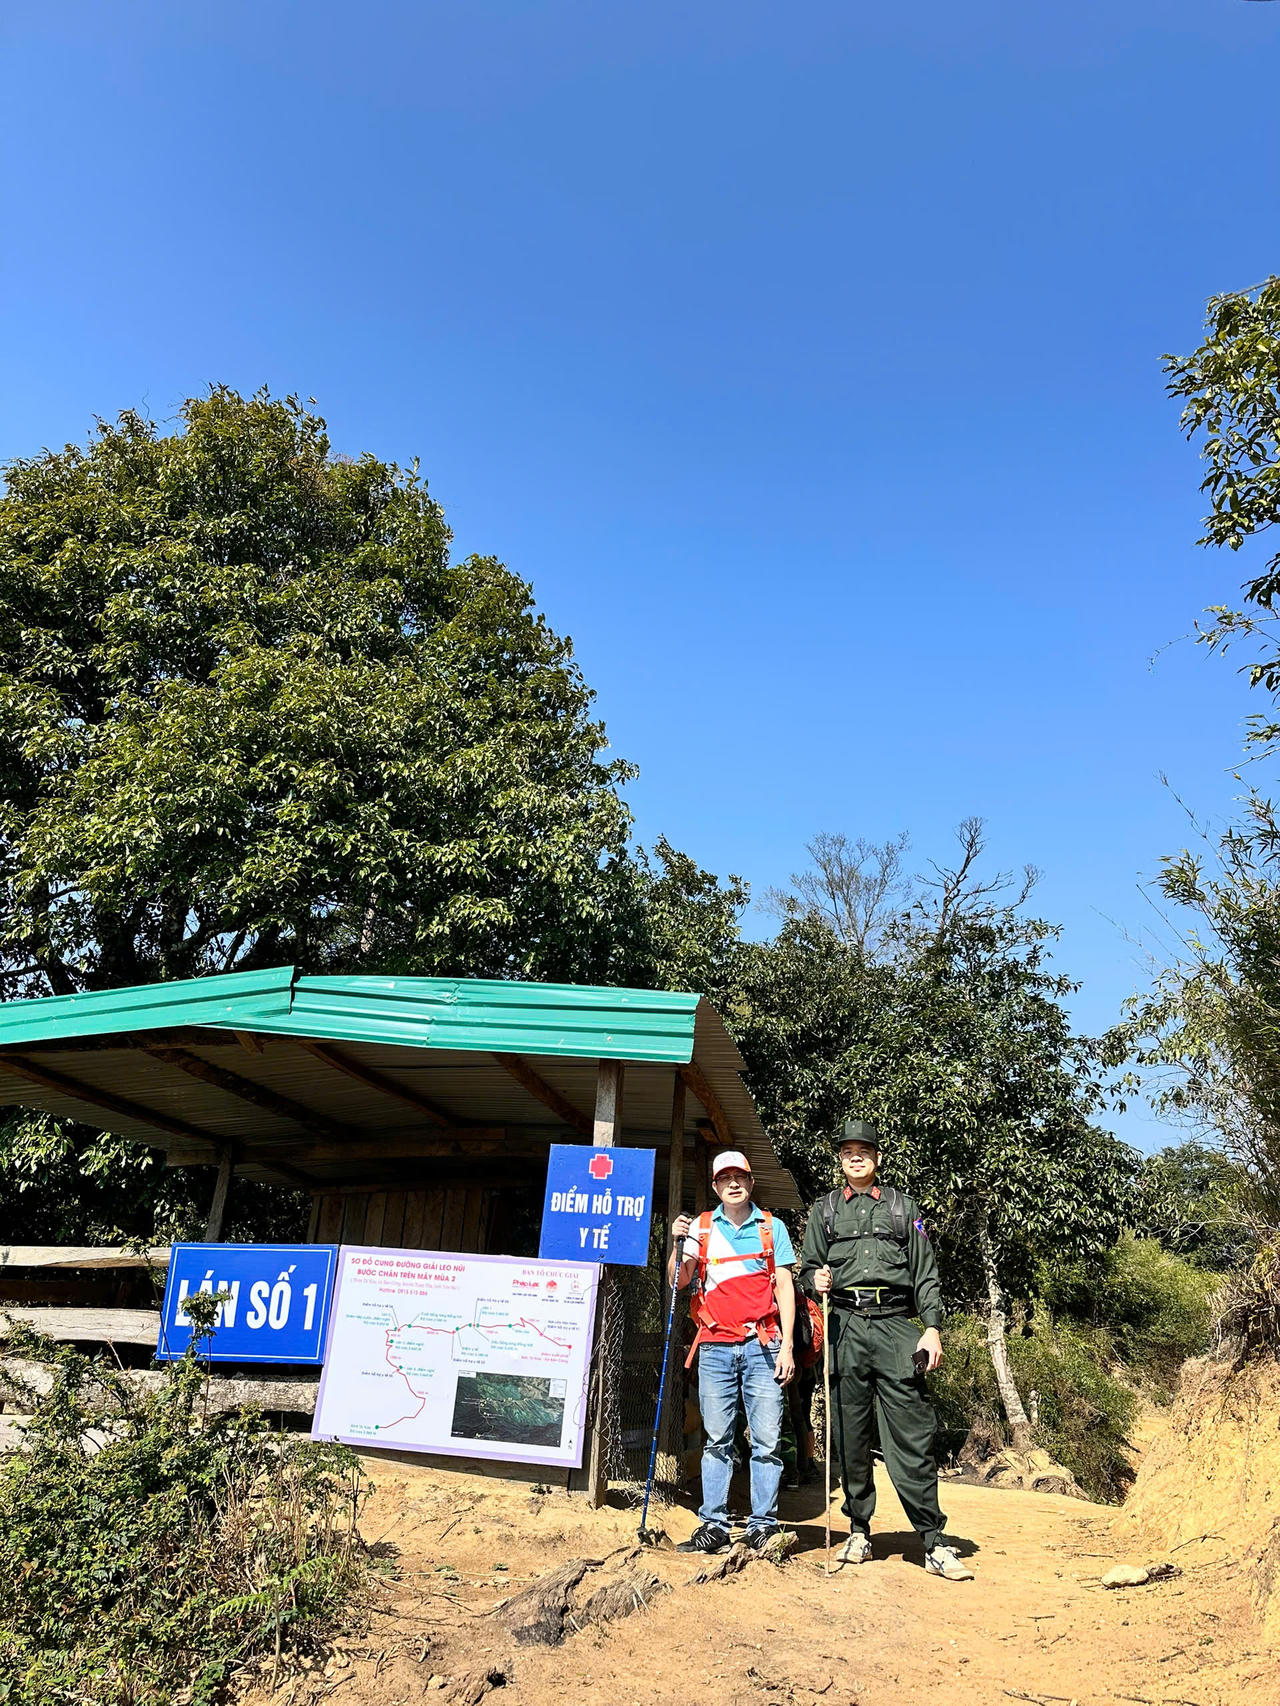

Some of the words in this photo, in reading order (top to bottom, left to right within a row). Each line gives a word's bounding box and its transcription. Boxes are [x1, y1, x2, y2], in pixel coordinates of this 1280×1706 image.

[551, 1185, 588, 1213] ĐIỂM
[591, 1188, 612, 1215] HỖ
[616, 1195, 645, 1221] TRỢ
[579, 1227, 589, 1248] Y
[592, 1222, 611, 1249] TẾ
[246, 1264, 297, 1330] SỐ
[303, 1283, 318, 1330] 1
